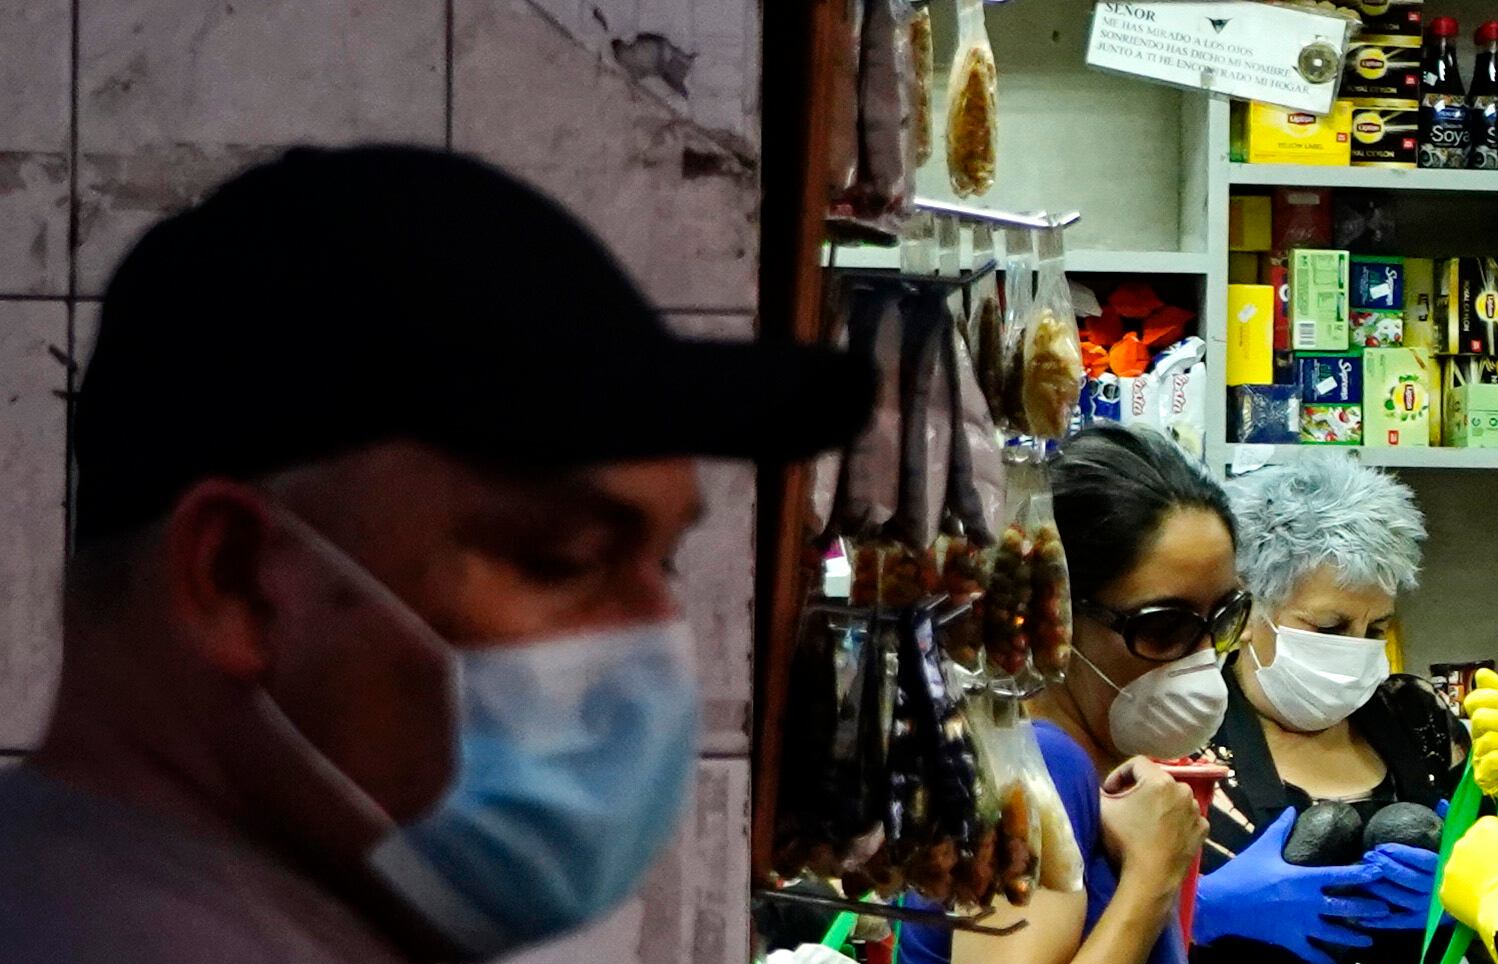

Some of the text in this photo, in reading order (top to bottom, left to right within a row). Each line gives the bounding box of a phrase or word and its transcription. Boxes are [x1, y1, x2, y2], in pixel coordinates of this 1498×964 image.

[1103, 1, 1156, 23] SEÑOR
[1100, 30, 1164, 52] SONRIENDO
[1166, 44, 1189, 57] HAS
[1190, 48, 1226, 64] DICHO
[1227, 55, 1243, 66] MI
[1102, 16, 1254, 56] ME HAS MIRADO A LOS OJOS
[1097, 43, 1133, 60] JUNTO
[1146, 52, 1158, 64] TI
[1158, 54, 1175, 67] HE
[1254, 75, 1269, 86] MI
[1270, 77, 1311, 96] HOGAR
[1431, 125, 1471, 146] Soya
[1405, 386, 1413, 410] Lipton
